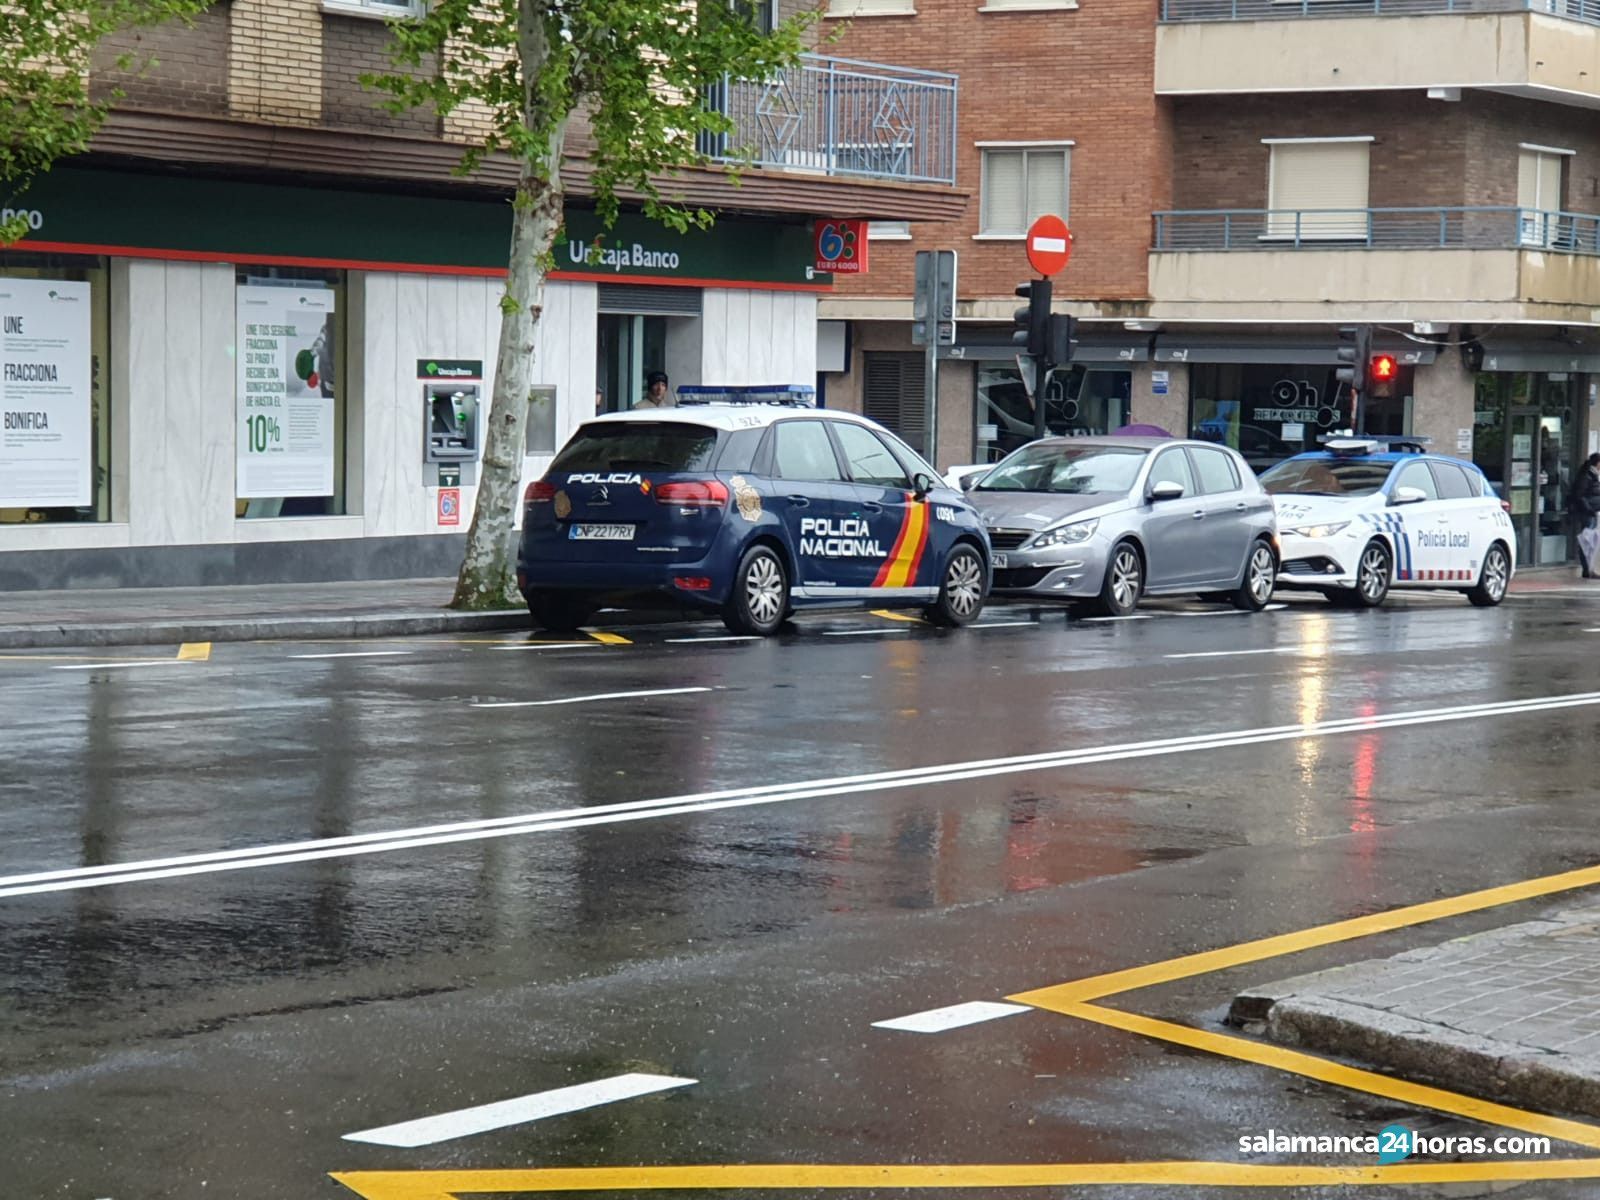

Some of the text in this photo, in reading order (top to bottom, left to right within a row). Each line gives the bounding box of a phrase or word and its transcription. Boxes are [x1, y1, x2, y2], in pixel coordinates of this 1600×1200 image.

[569, 239, 680, 272] Uncaja Banco
[4, 315, 24, 335] UNE
[4, 363, 58, 382] FRACCIONA
[4, 411, 49, 430] BONIFICA
[246, 414, 281, 453] 10%
[567, 472, 642, 485] POLICÍA
[801, 516, 870, 537] POLICÍA
[800, 538, 888, 557] NACIONAL
[1417, 528, 1471, 548] Policía Local
